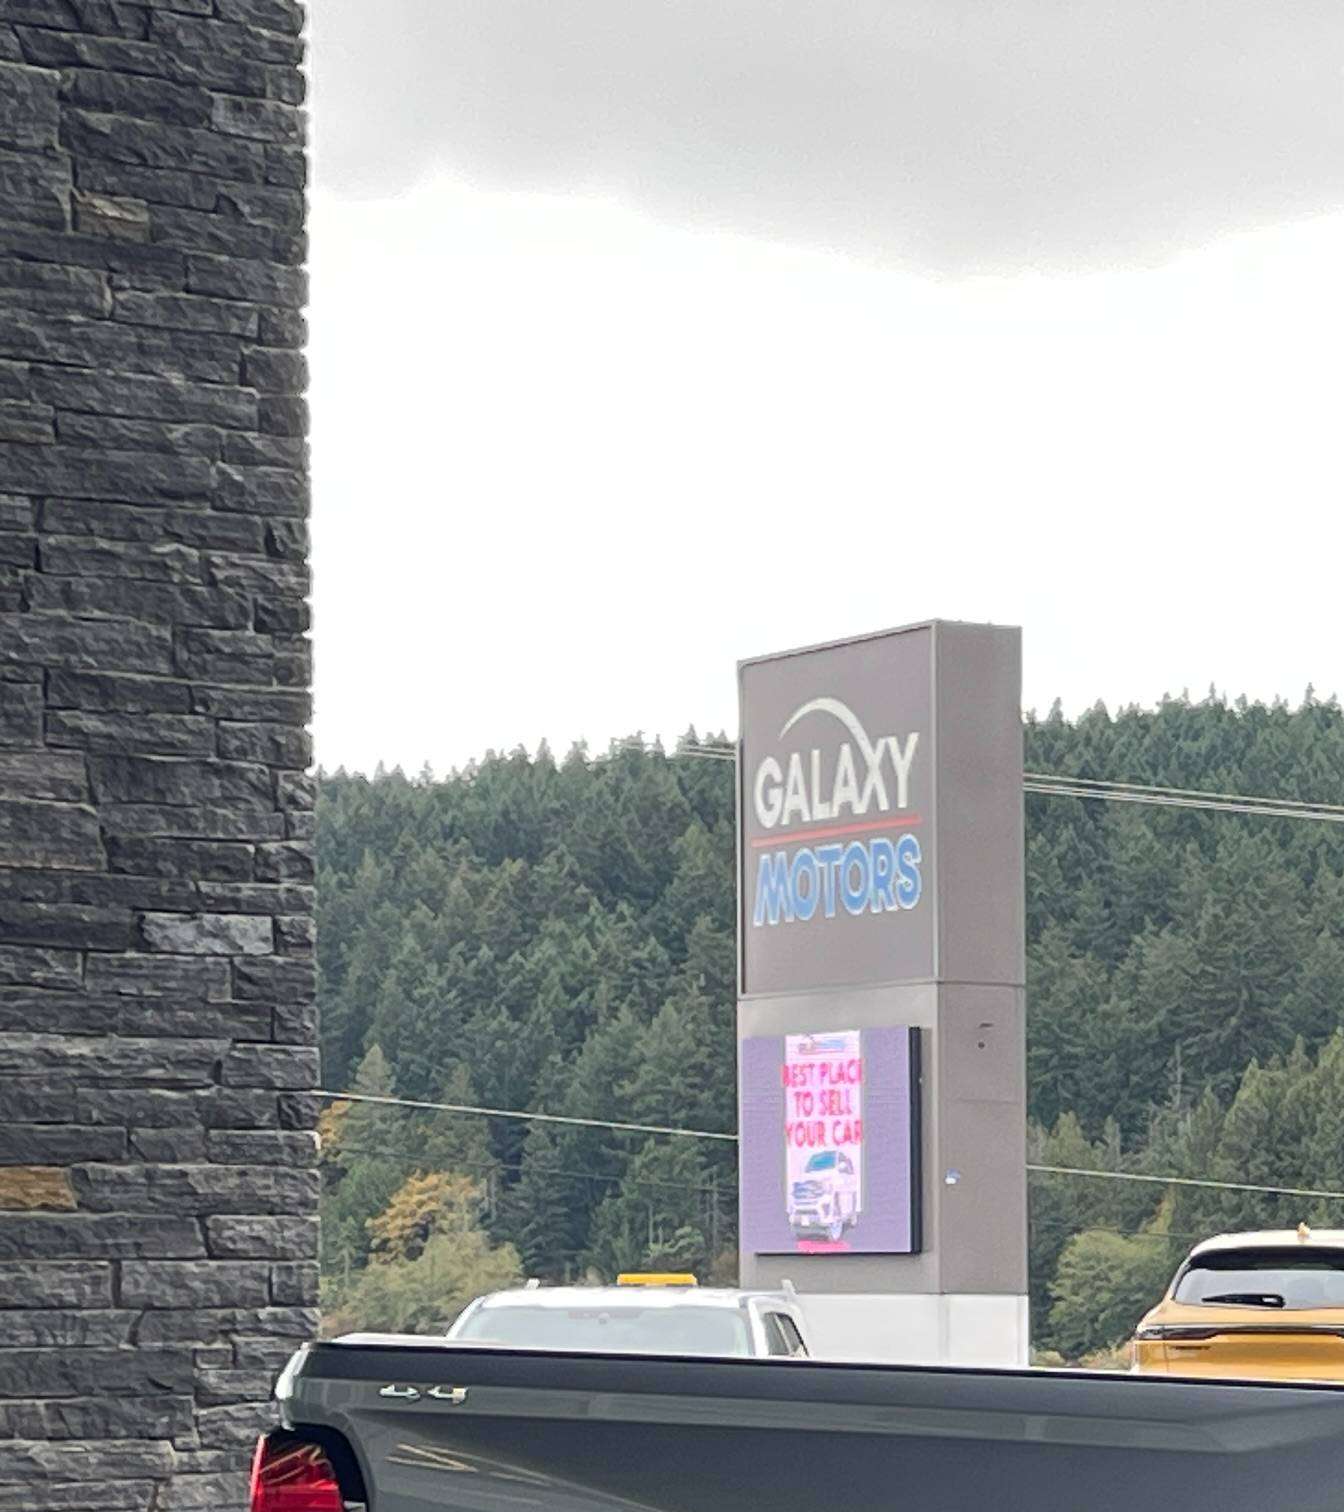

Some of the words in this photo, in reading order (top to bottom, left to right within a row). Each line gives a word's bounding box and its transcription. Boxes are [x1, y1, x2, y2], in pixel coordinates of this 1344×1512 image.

[754, 731, 920, 829] GALAXY
[753, 834, 922, 927] MOTORS
[784, 1121, 827, 1147] YOUR
[833, 1119, 863, 1145] CAR
[794, 1091, 814, 1117] TO
[819, 1089, 852, 1115] SELL
